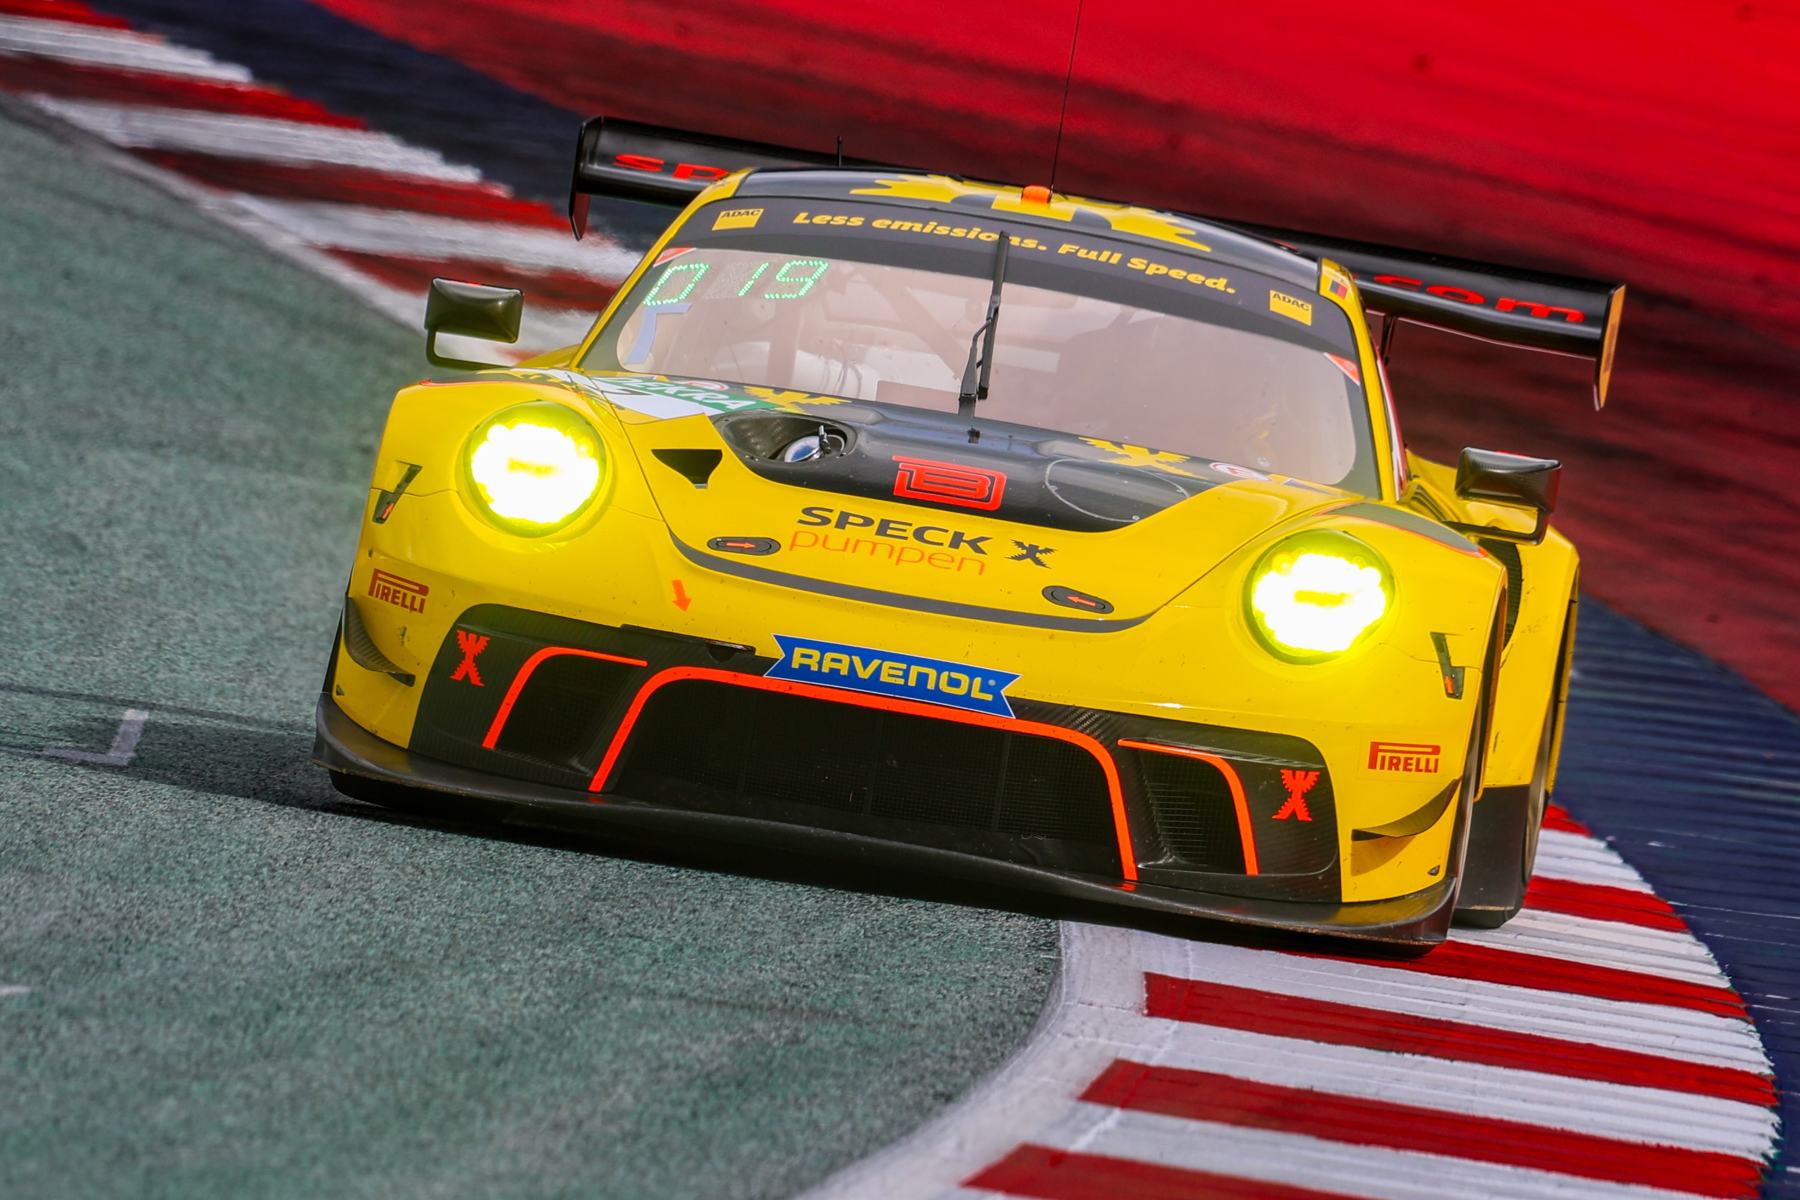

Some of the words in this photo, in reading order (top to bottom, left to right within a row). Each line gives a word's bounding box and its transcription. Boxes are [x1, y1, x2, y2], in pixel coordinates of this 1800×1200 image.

[793, 212, 865, 227] Less
[872, 218, 1047, 251] emissions.
[1057, 243, 1122, 265] Full
[1127, 257, 1236, 294] Speed.
[1272, 292, 1311, 313] ADAC
[594, 377, 756, 410] DEKRA
[788, 530, 987, 576] pumpen
[797, 506, 994, 555] SPECK
[368, 568, 429, 613] PIRELLI
[791, 647, 994, 701] RAVENOL
[1368, 741, 1441, 773] PIRELLI
